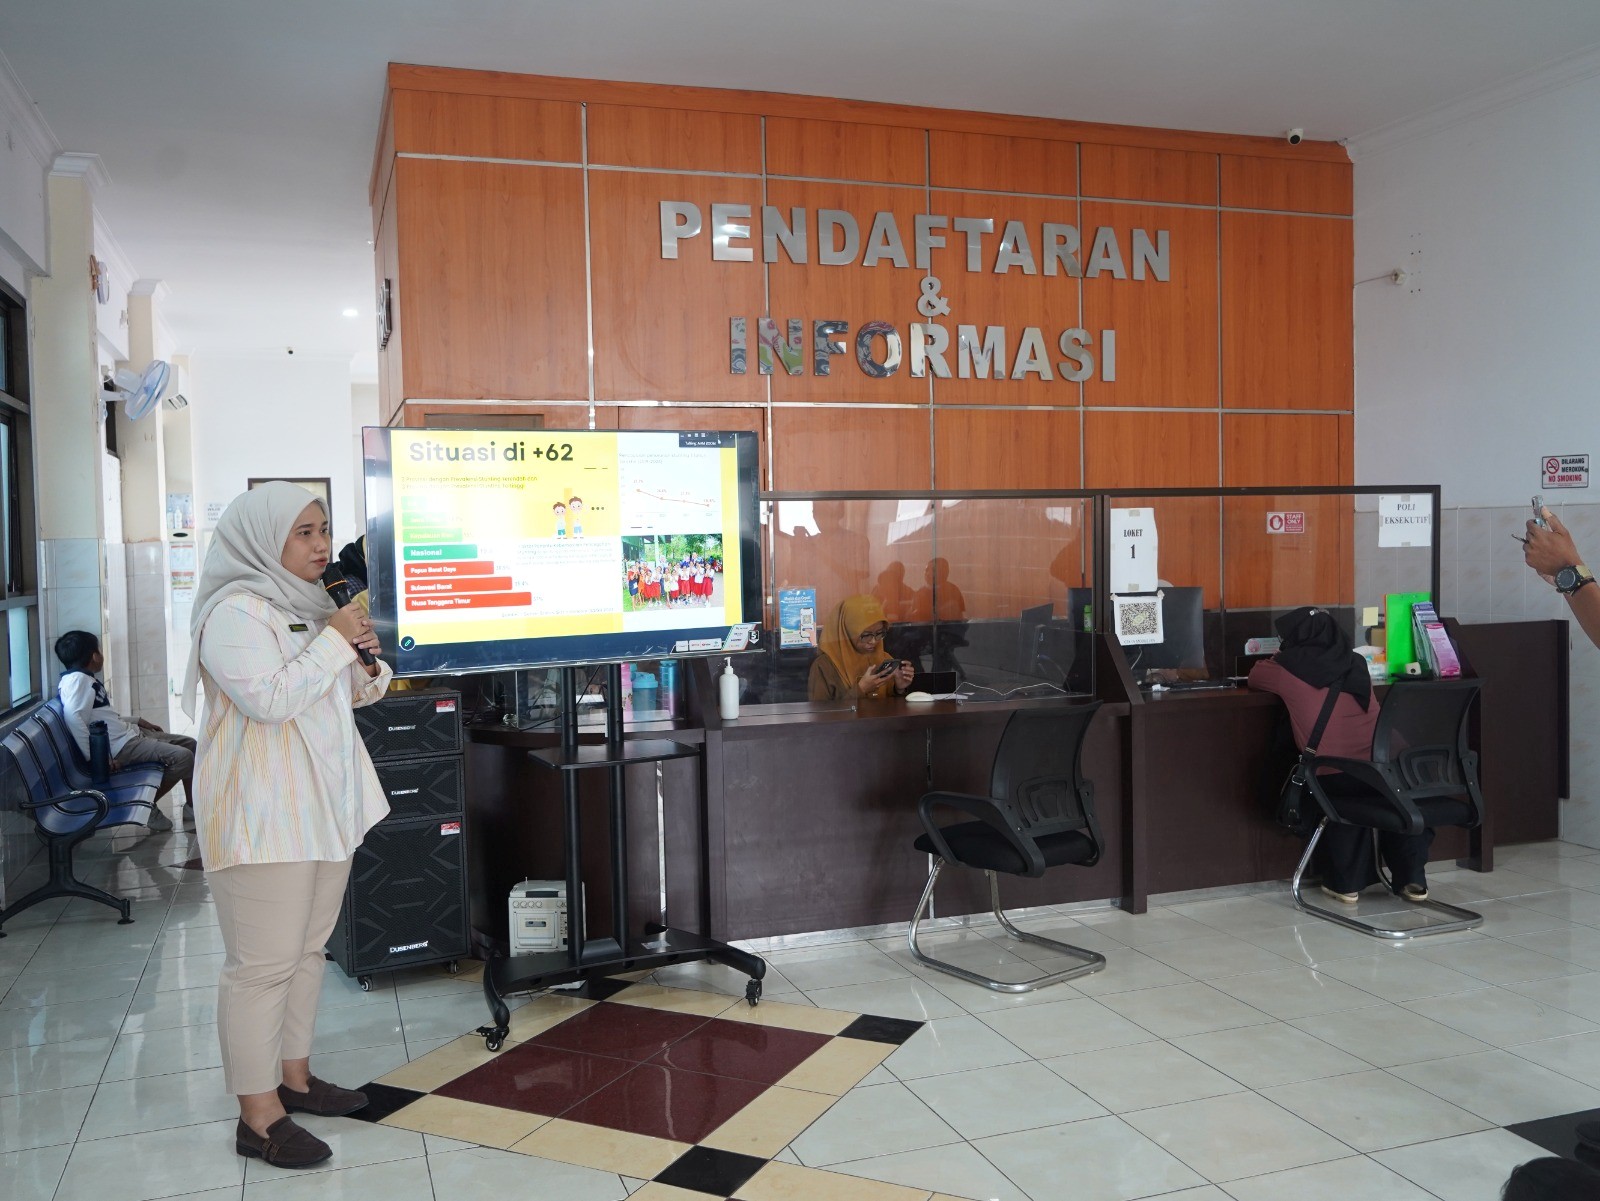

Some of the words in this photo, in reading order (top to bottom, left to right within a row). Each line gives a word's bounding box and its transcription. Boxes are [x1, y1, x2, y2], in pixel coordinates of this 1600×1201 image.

[660, 201, 1170, 281] PENDAFTARAN
[917, 277, 951, 317] &
[730, 316, 1116, 382] INFORMASI
[409, 441, 496, 462] Situasi
[503, 441, 525, 461] di
[532, 443, 574, 462] +62
[1561, 457, 1585, 465] DILARANG
[1548, 475, 1556, 483] NO
[1557, 474, 1582, 482] SMOKING
[1397, 503, 1416, 511] POLI
[1384, 516, 1428, 525] EKSEKUTIF
[1123, 528, 1144, 538] LOKET
[410, 548, 443, 557] Nasional
[1130, 543, 1136, 559] 1
[410, 567, 428, 575] Papua
[410, 583, 437, 591] Sulawesi
[426, 599, 454, 607] Tenggara
[453, 597, 471, 605] Timur
[389, 940, 429, 954] DUSENBERG
